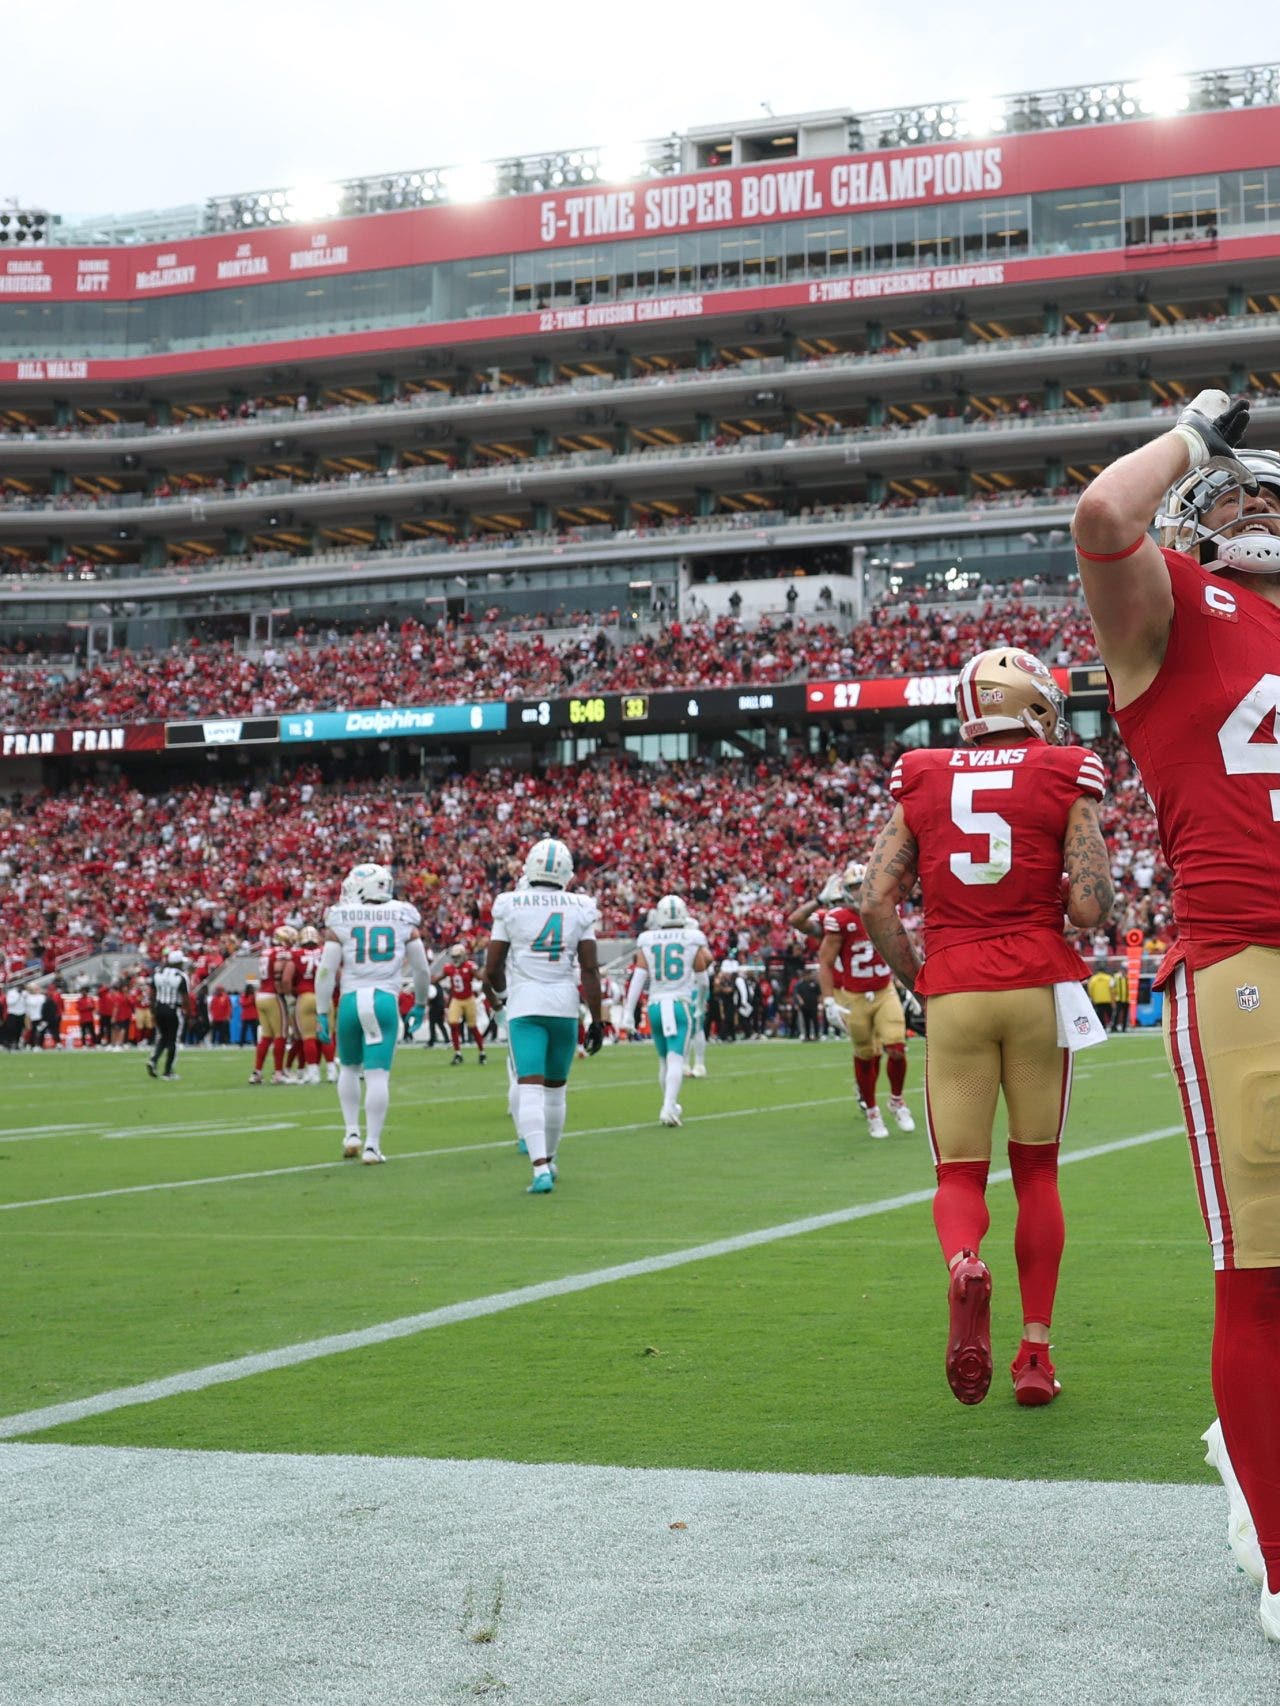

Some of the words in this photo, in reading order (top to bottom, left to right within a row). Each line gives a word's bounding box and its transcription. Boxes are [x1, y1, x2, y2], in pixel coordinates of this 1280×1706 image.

[541, 194, 634, 242] 5-TIME
[645, 179, 732, 229] SUPER
[741, 168, 822, 219] BOWL
[831, 147, 1003, 207] CHAMPIONS
[217, 256, 269, 279] MONTANA
[933, 265, 1004, 289] CHAMPIONS
[637, 296, 703, 321] CHAMPIONS
[1205, 585, 1236, 614] C
[833, 683, 861, 708] 27
[345, 709, 435, 734] Dolphins
[538, 701, 550, 725] 3
[3, 732, 54, 755] FRAN
[72, 729, 125, 751] FRAN
[949, 748, 1028, 767] EVANS
[950, 770, 1014, 885] 5
[513, 894, 584, 908] MARSHALL
[351, 926, 396, 964] 10
[531, 912, 564, 962] 4
[651, 943, 685, 981] 16
[1241, 996, 1258, 1006] NFL
